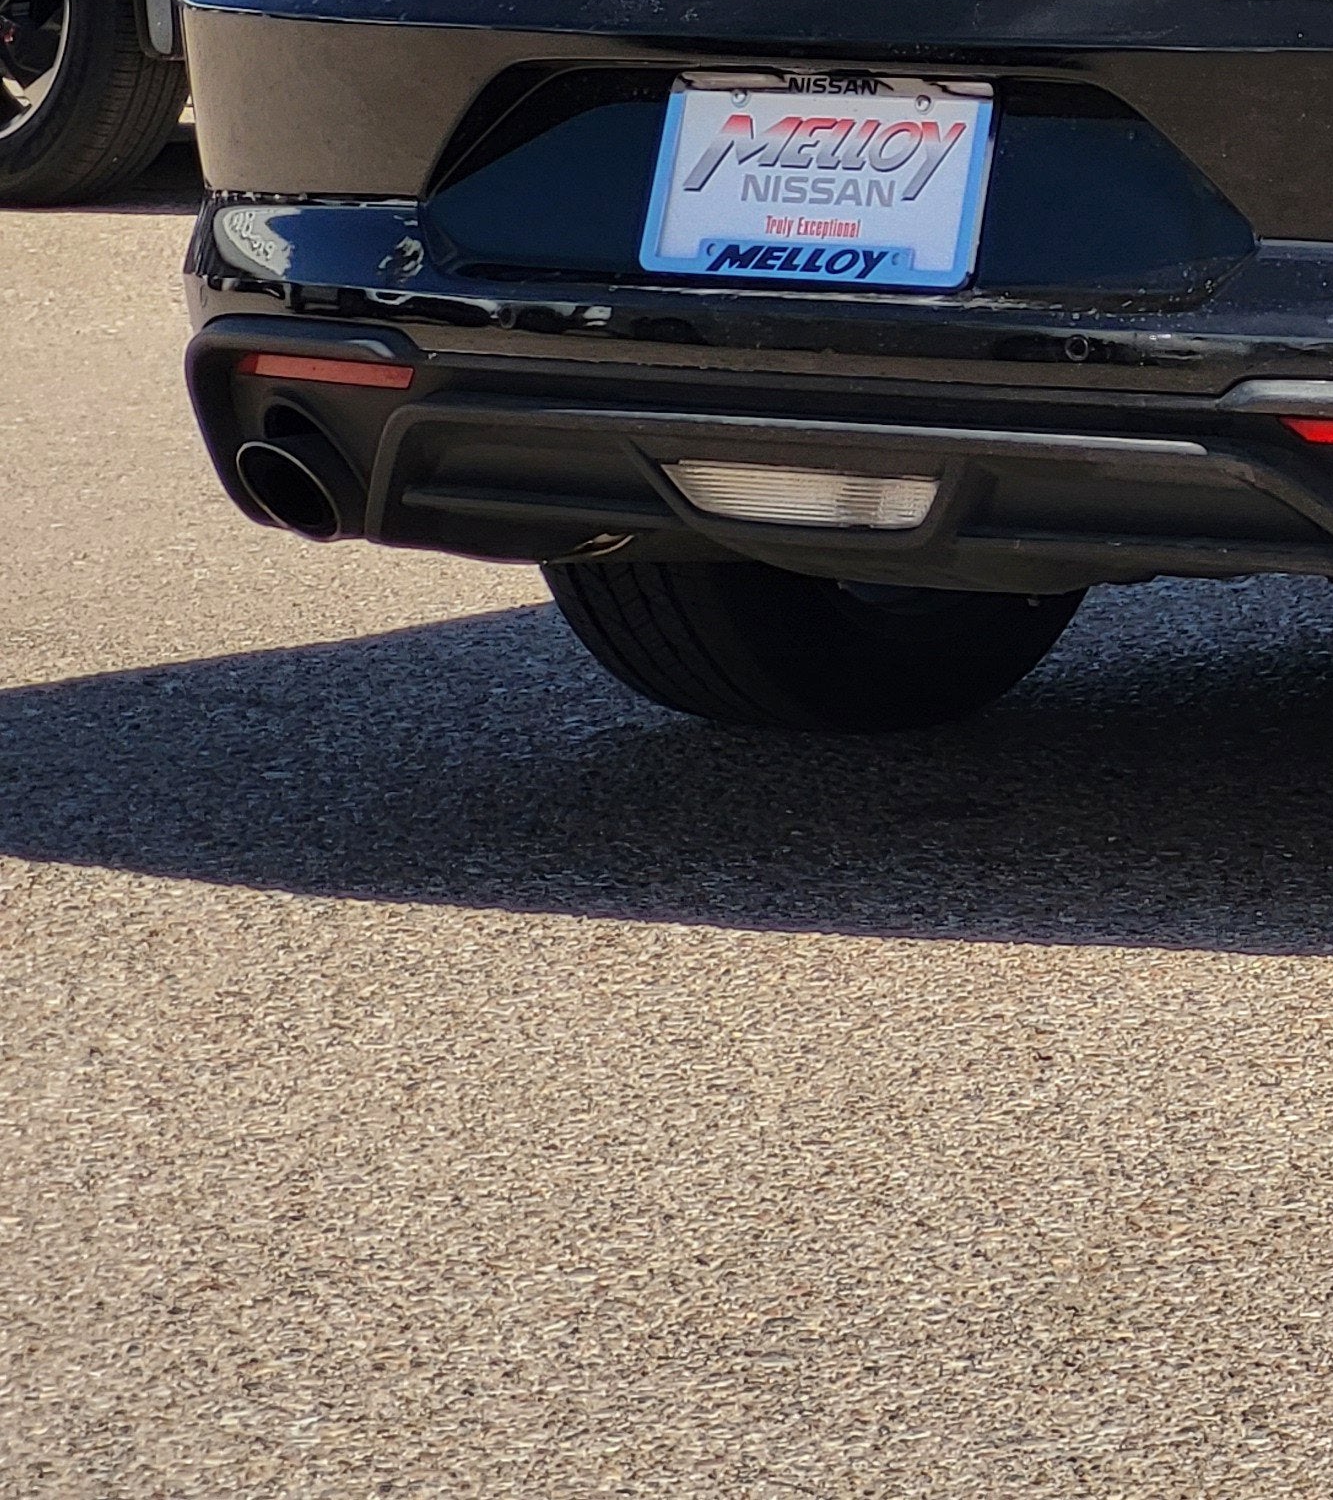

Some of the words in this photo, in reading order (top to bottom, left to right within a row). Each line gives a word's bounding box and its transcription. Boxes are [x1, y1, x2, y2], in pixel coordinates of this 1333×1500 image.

[787, 75, 880, 96] NISSAN
[682, 113, 967, 202] MELLOY
[740, 173, 897, 209] NISSAN
[765, 214, 793, 238] Truly
[796, 215, 862, 240] Exceptional
[706, 243, 889, 280] MELLOY
